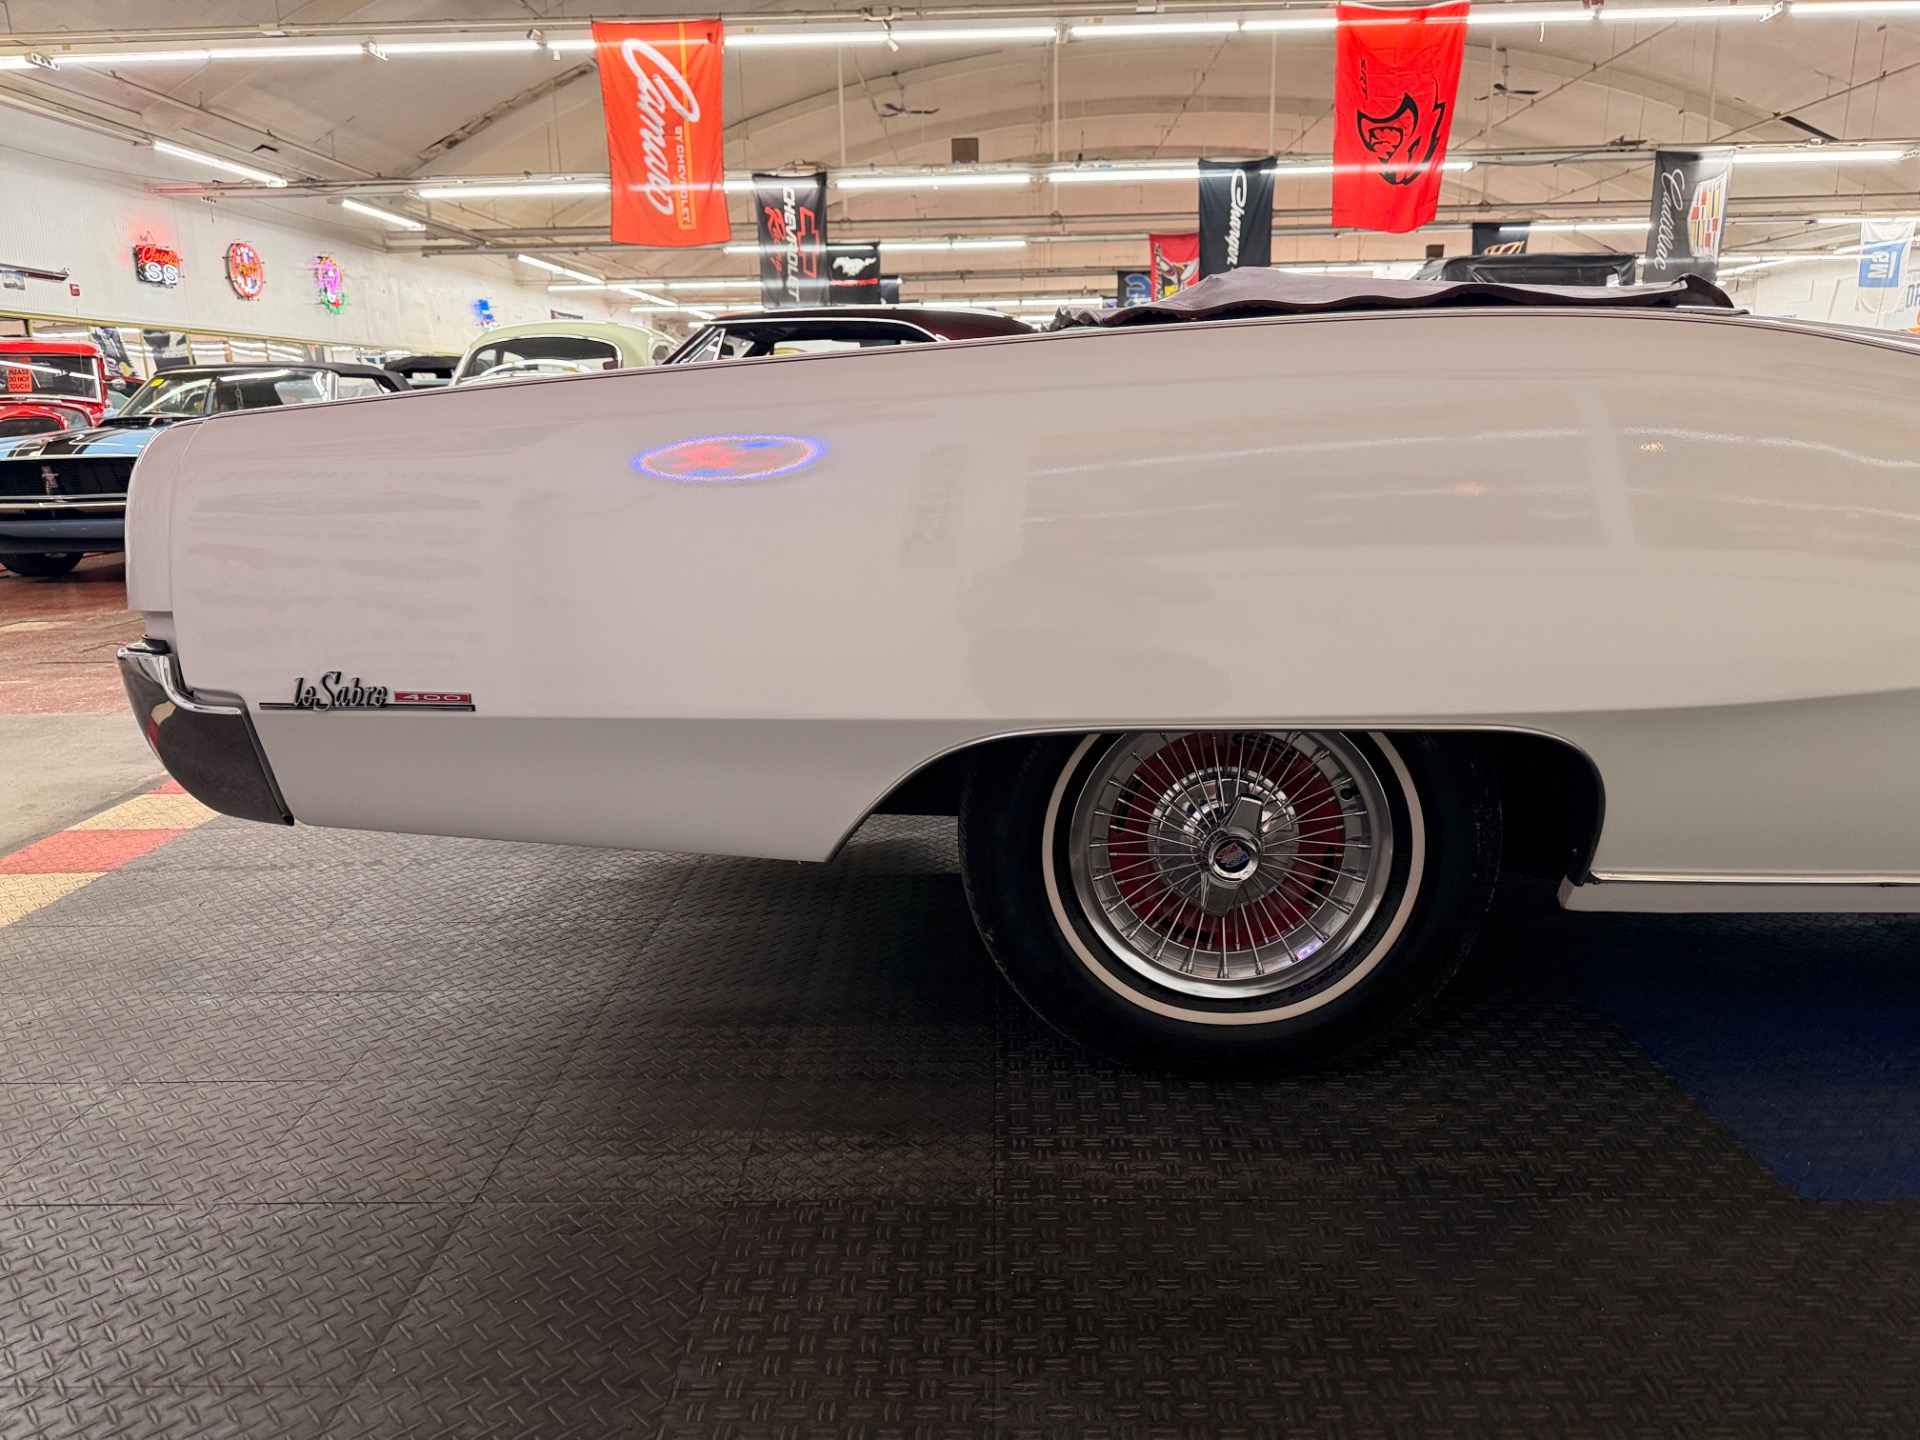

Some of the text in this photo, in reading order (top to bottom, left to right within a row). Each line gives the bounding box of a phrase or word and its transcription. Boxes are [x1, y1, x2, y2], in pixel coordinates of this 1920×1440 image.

[1359, 54, 1369, 101] SRT
[621, 37, 700, 216] Camaro
[674, 125, 690, 224] BY CHEVROLET
[764, 206, 786, 273] Racng
[782, 186, 800, 302] CHEVROLET
[1224, 168, 1247, 266] Charger
[1654, 168, 1685, 271] Cadillac
[145, 261, 179, 284] SS
[1867, 251, 1890, 279] GM
[402, 693, 461, 701] 400
